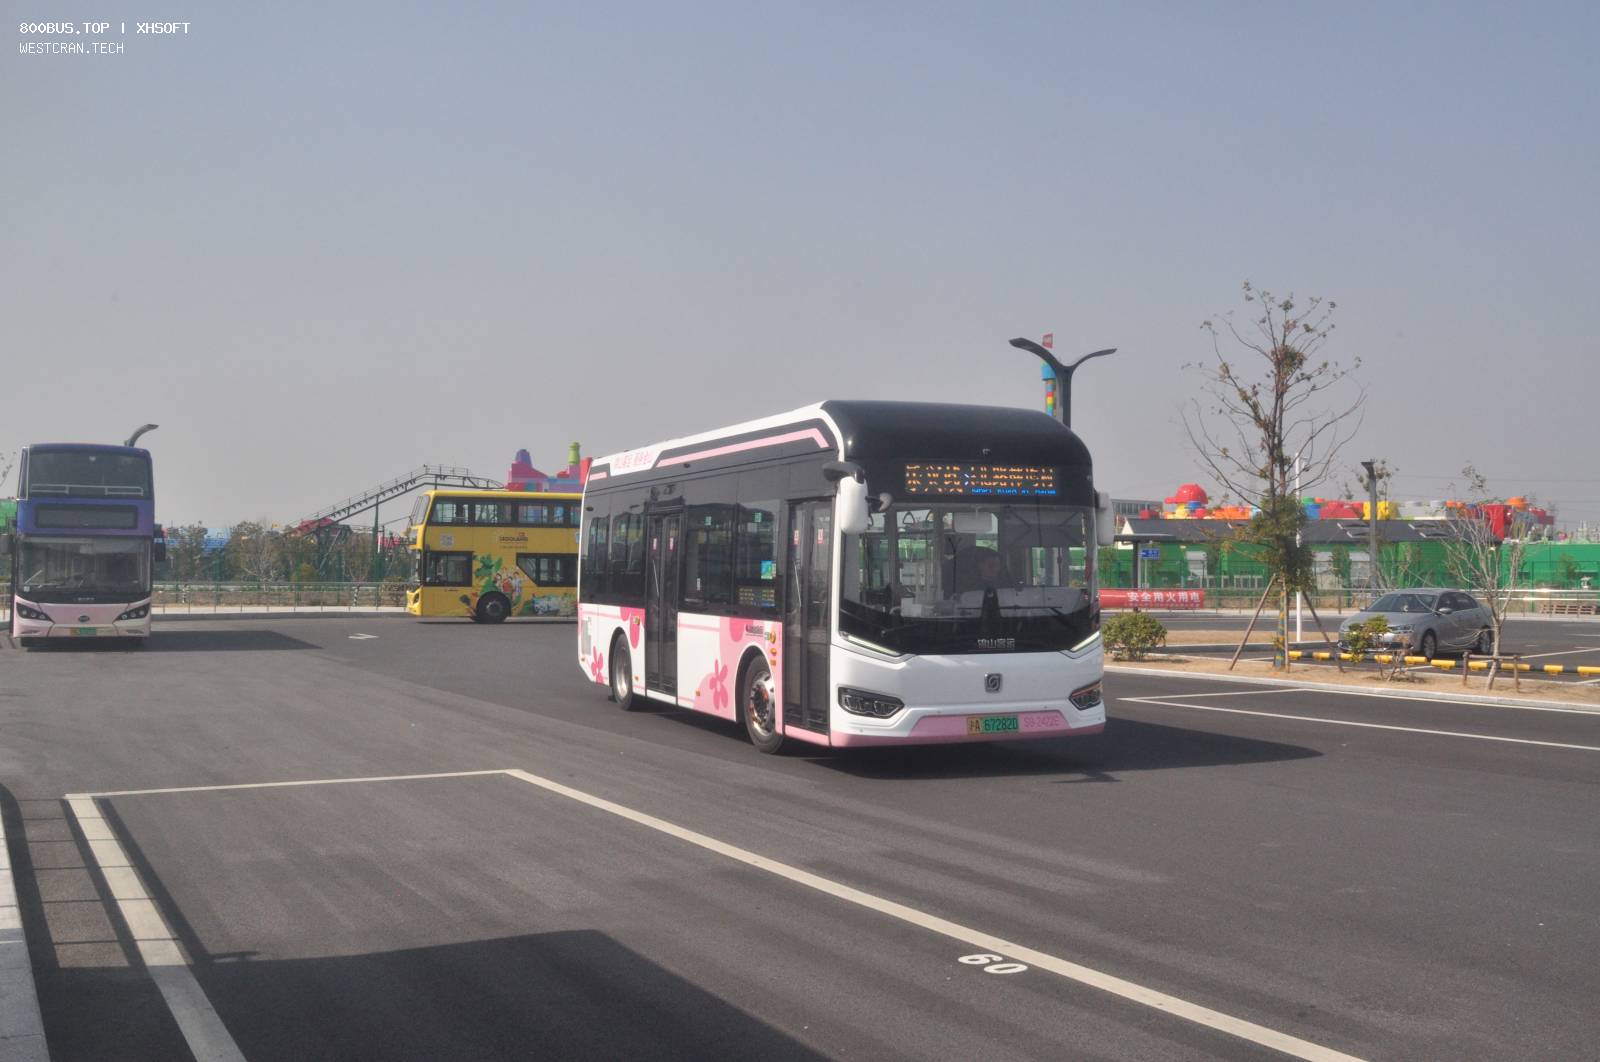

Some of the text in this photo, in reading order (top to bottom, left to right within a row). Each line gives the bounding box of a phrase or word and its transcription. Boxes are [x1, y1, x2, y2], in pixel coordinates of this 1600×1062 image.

[1127, 591, 1201, 603] 安全用火用电
[957, 953, 1029, 974] 60
